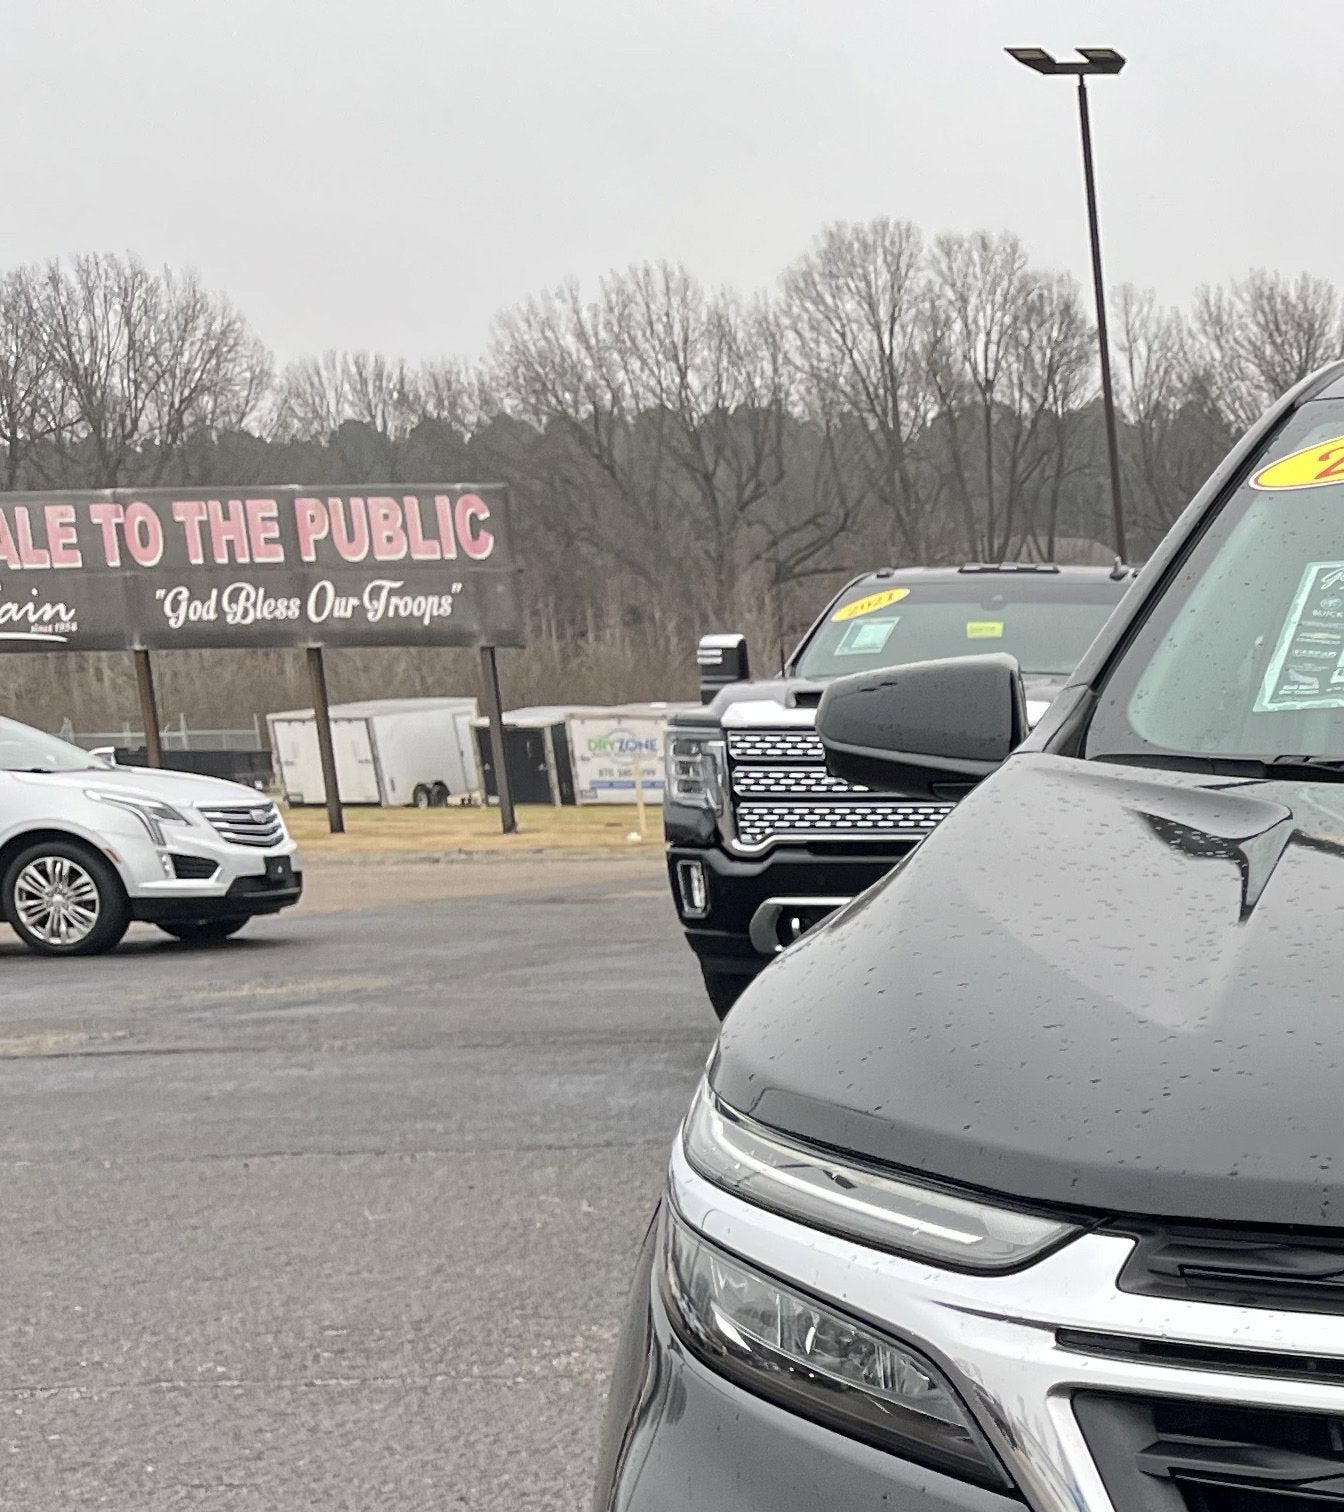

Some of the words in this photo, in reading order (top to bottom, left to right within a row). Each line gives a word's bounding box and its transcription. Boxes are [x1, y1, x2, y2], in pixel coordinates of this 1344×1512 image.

[89, 501, 164, 568] TO
[172, 499, 285, 565] THE
[295, 493, 494, 562] PUBLIC
[0, 582, 75, 625] ain
[155, 585, 218, 629] "God
[222, 581, 300, 625] Bless
[307, 579, 360, 623] Our
